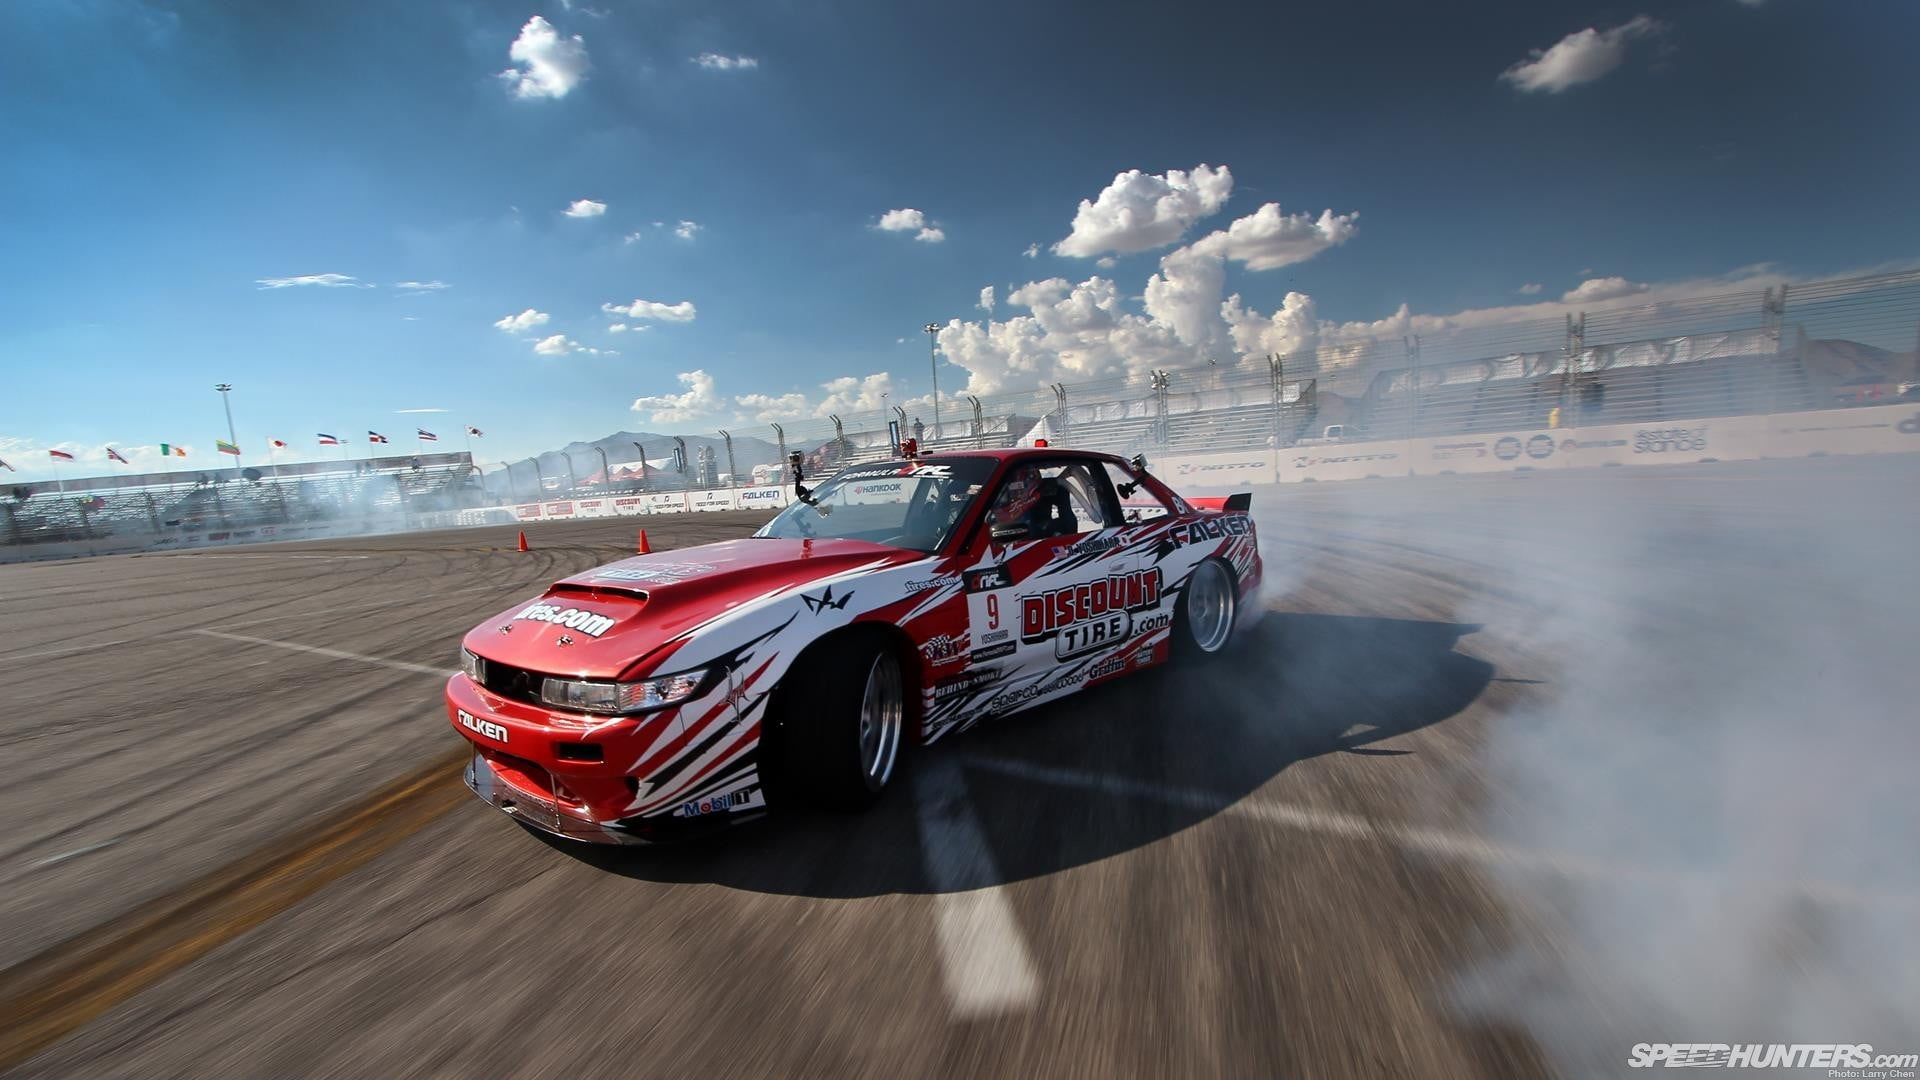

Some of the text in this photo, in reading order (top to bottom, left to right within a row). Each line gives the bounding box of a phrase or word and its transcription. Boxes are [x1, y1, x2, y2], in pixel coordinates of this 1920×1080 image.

[742, 490, 780, 500] FALKEN
[1168, 516, 1250, 549] FALKEN
[987, 594, 998, 630] 9
[1021, 566, 1162, 644] DISCOUNT
[1065, 613, 1169, 650] TIRE .com
[457, 708, 508, 743] FALKEN
[684, 794, 731, 816] Mobil
